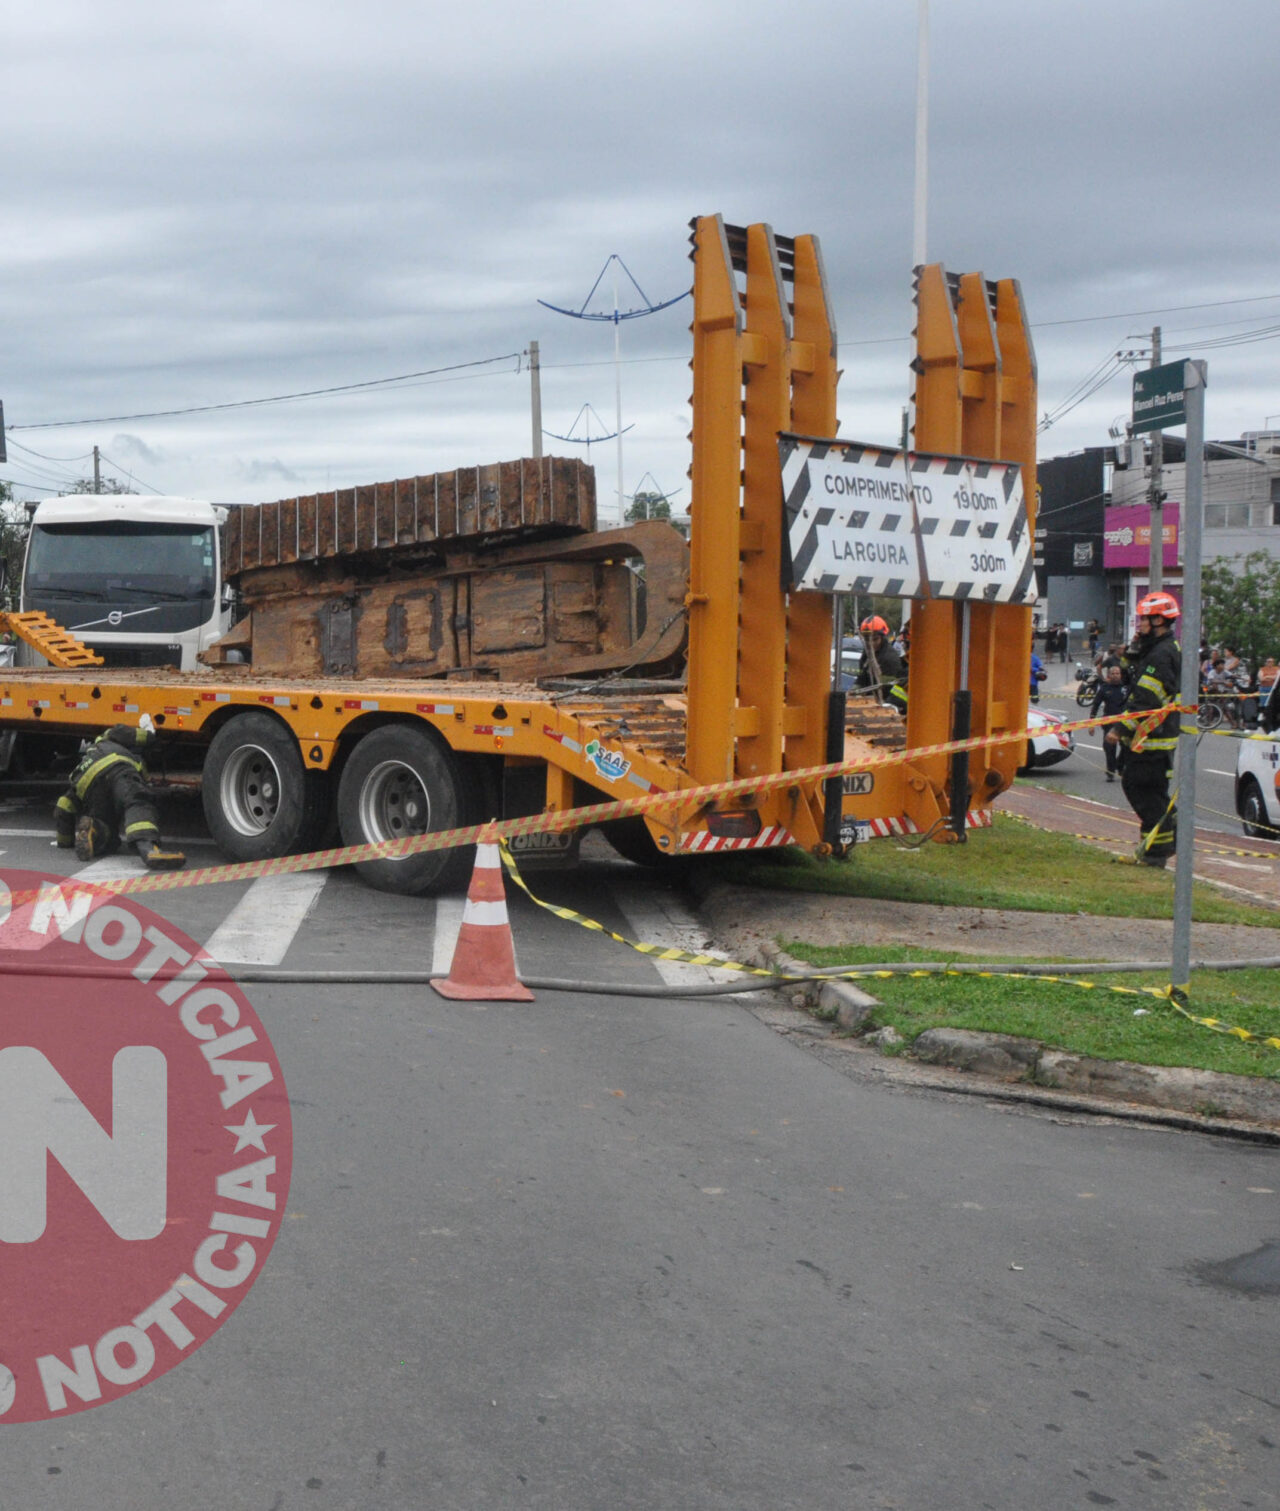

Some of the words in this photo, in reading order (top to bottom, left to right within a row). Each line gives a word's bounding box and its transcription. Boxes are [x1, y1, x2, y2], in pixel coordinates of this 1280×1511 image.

[824, 474, 932, 504] COMPRIMENTO
[832, 540, 909, 565] LARGURA
[596, 747, 630, 771] SAAE
